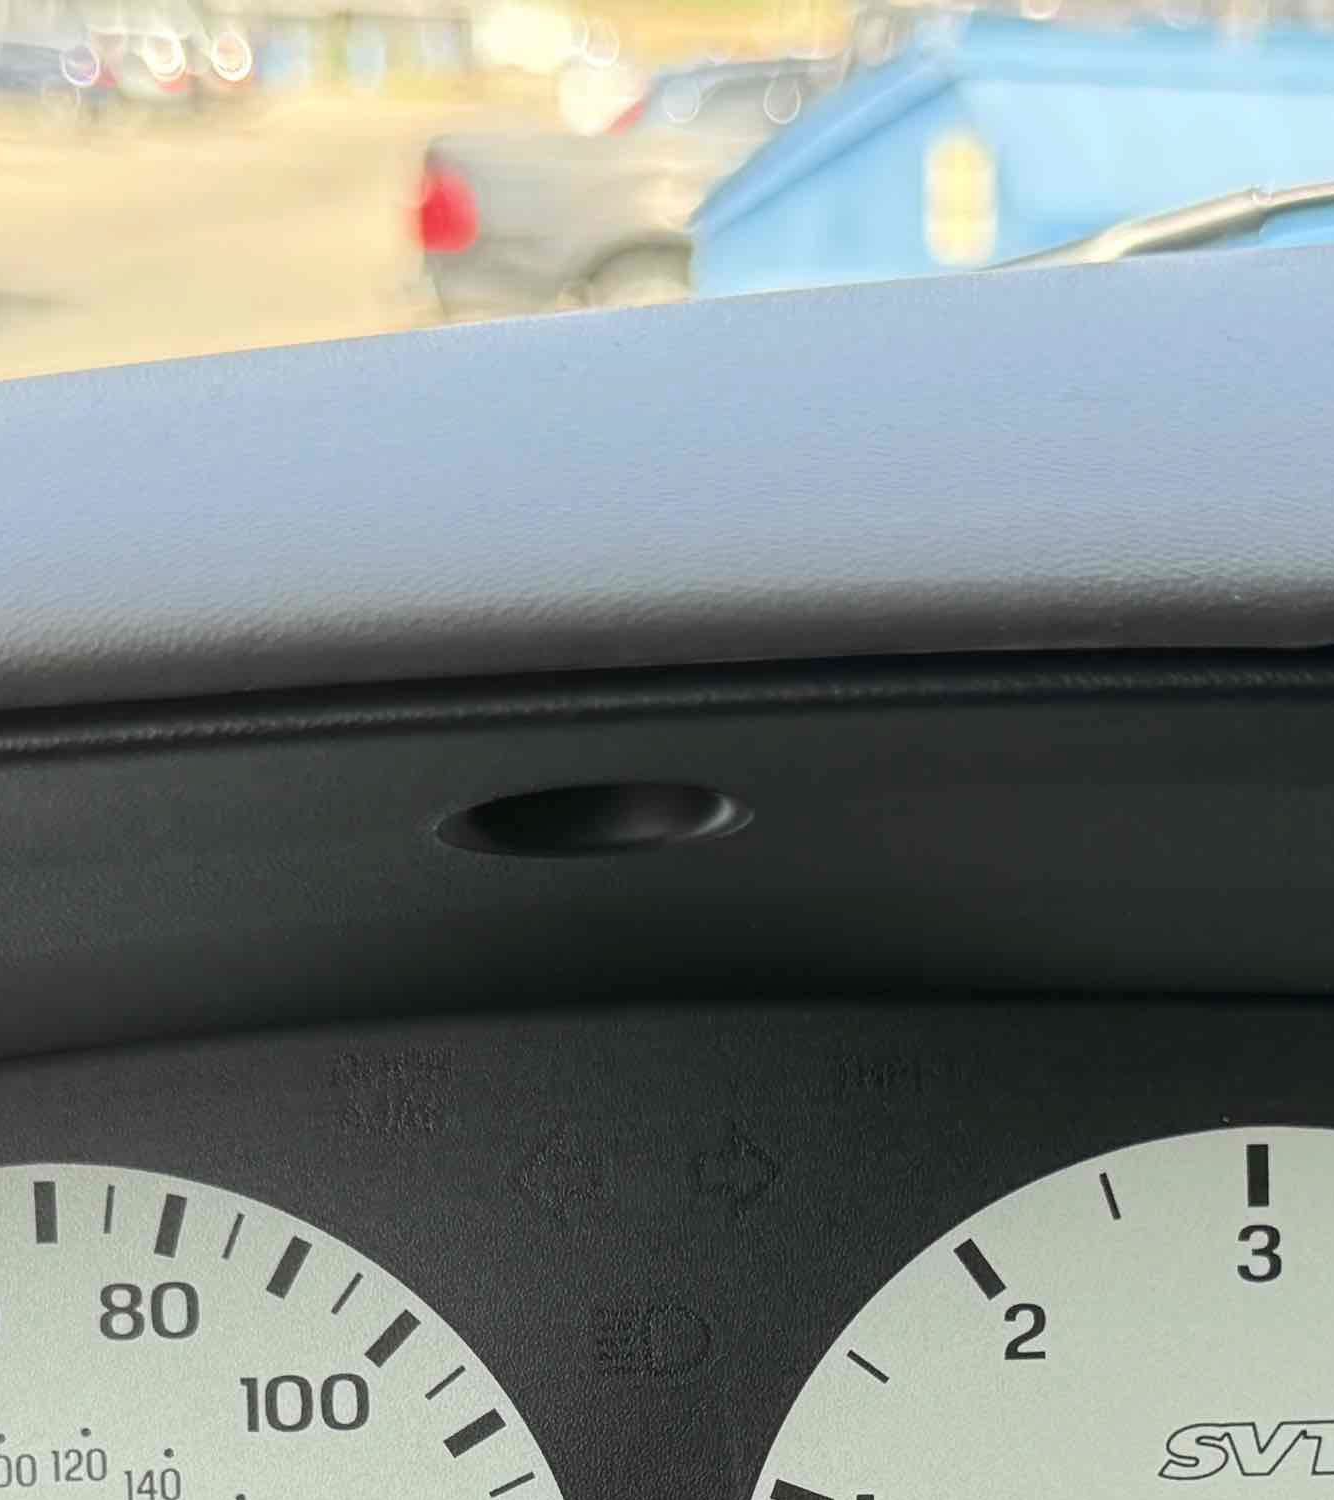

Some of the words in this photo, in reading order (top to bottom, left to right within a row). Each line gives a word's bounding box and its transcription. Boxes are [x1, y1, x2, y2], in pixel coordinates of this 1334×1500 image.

[1238, 1225, 1281, 1282] 3
[100, 1282, 199, 1340] 80
[1005, 1303, 1046, 1360] 2
[240, 1373, 369, 1432] 100
[51, 1448, 107, 1482] 120
